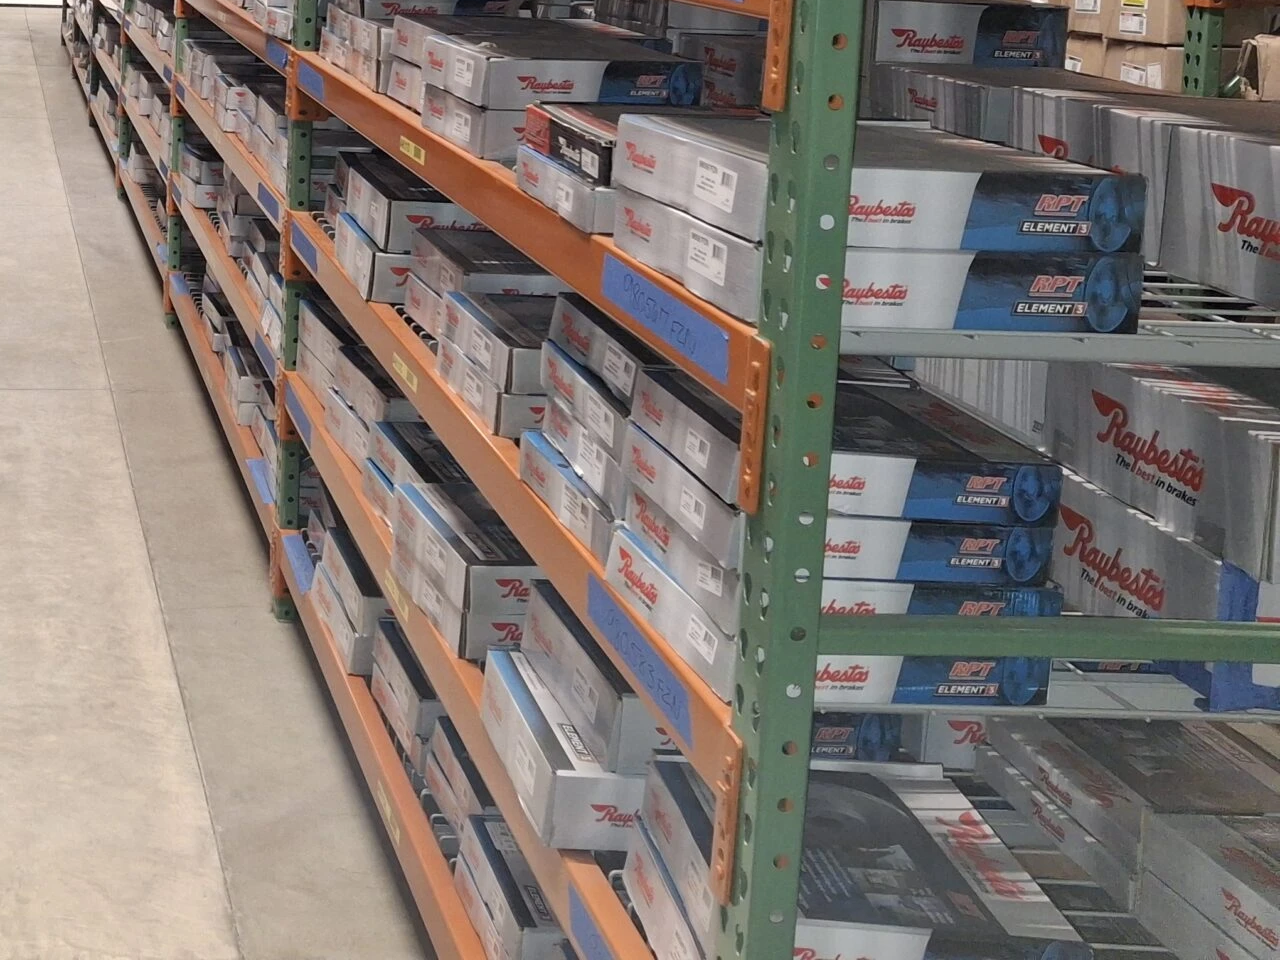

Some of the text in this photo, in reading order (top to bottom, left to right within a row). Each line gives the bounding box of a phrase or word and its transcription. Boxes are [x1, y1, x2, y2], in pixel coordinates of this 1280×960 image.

[892, 28, 965, 53] Raybestos
[994, 50, 1031, 59] ELEMENT
[517, 76, 575, 91] Raybestos
[1034, 195, 1089, 213] RPT
[1023, 222, 1088, 234] ELEMENT 3
[1241, 239, 1259, 254] The
[1029, 275, 1086, 293] RPT
[1017, 303, 1085, 315] ELEMENT 3
[1091, 389, 1206, 492] Raybestos
[829, 474, 867, 490] bestos
[964, 475, 1007, 490] RPT
[1115, 453, 1197, 507] The best in brakes
[956, 495, 998, 505] ELEMENT
[825, 539, 861, 555] bestos
[958, 538, 1000, 552] RPT
[950, 557, 991, 567] ELEMENT
[1060, 504, 1166, 612] Raybestos
[1080, 568, 1096, 585] The
[1098, 580, 1118, 602] best
[1117, 591, 1126, 604] in
[949, 662, 996, 678] RPT
[937, 685, 996, 696] ELEMENT 3
[811, 745, 845, 754] LEMENT
